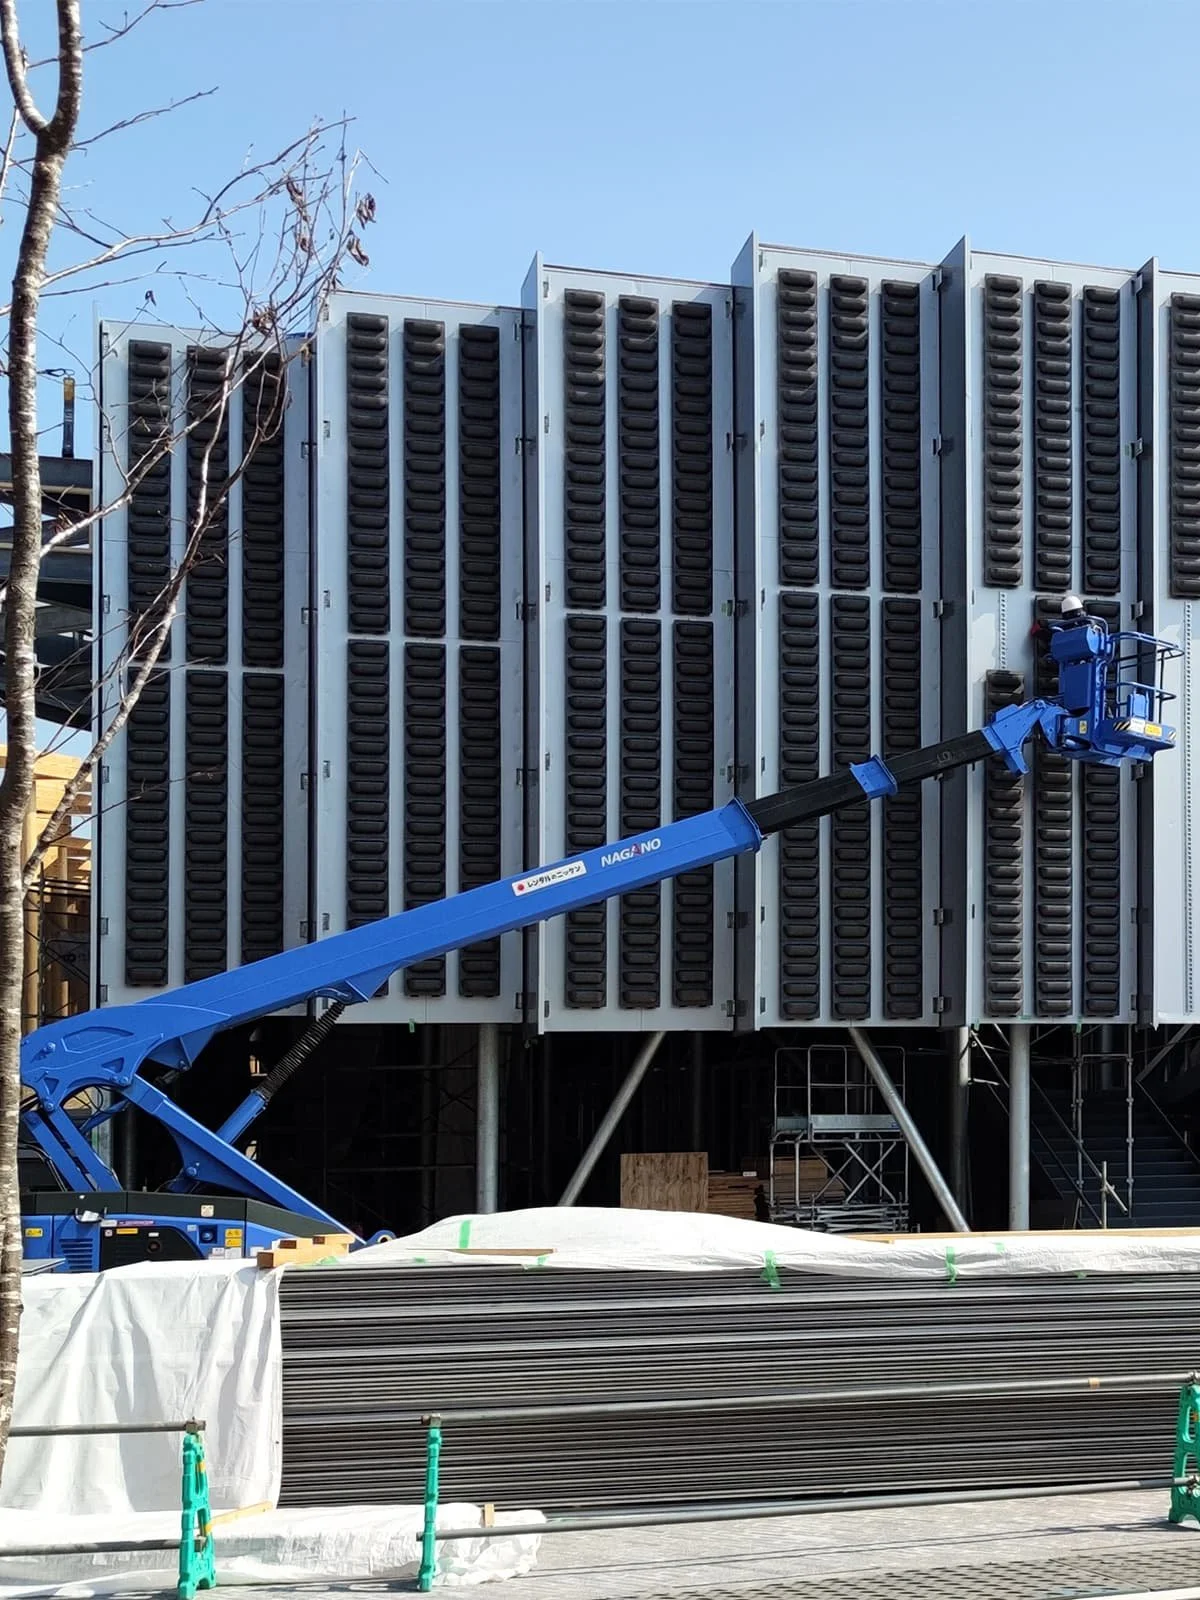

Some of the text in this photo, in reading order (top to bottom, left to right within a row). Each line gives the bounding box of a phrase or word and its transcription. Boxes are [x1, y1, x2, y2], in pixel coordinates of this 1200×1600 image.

[600, 838, 661, 867] NAGANO
[527, 865, 581, 888] レンタルのニッケン
